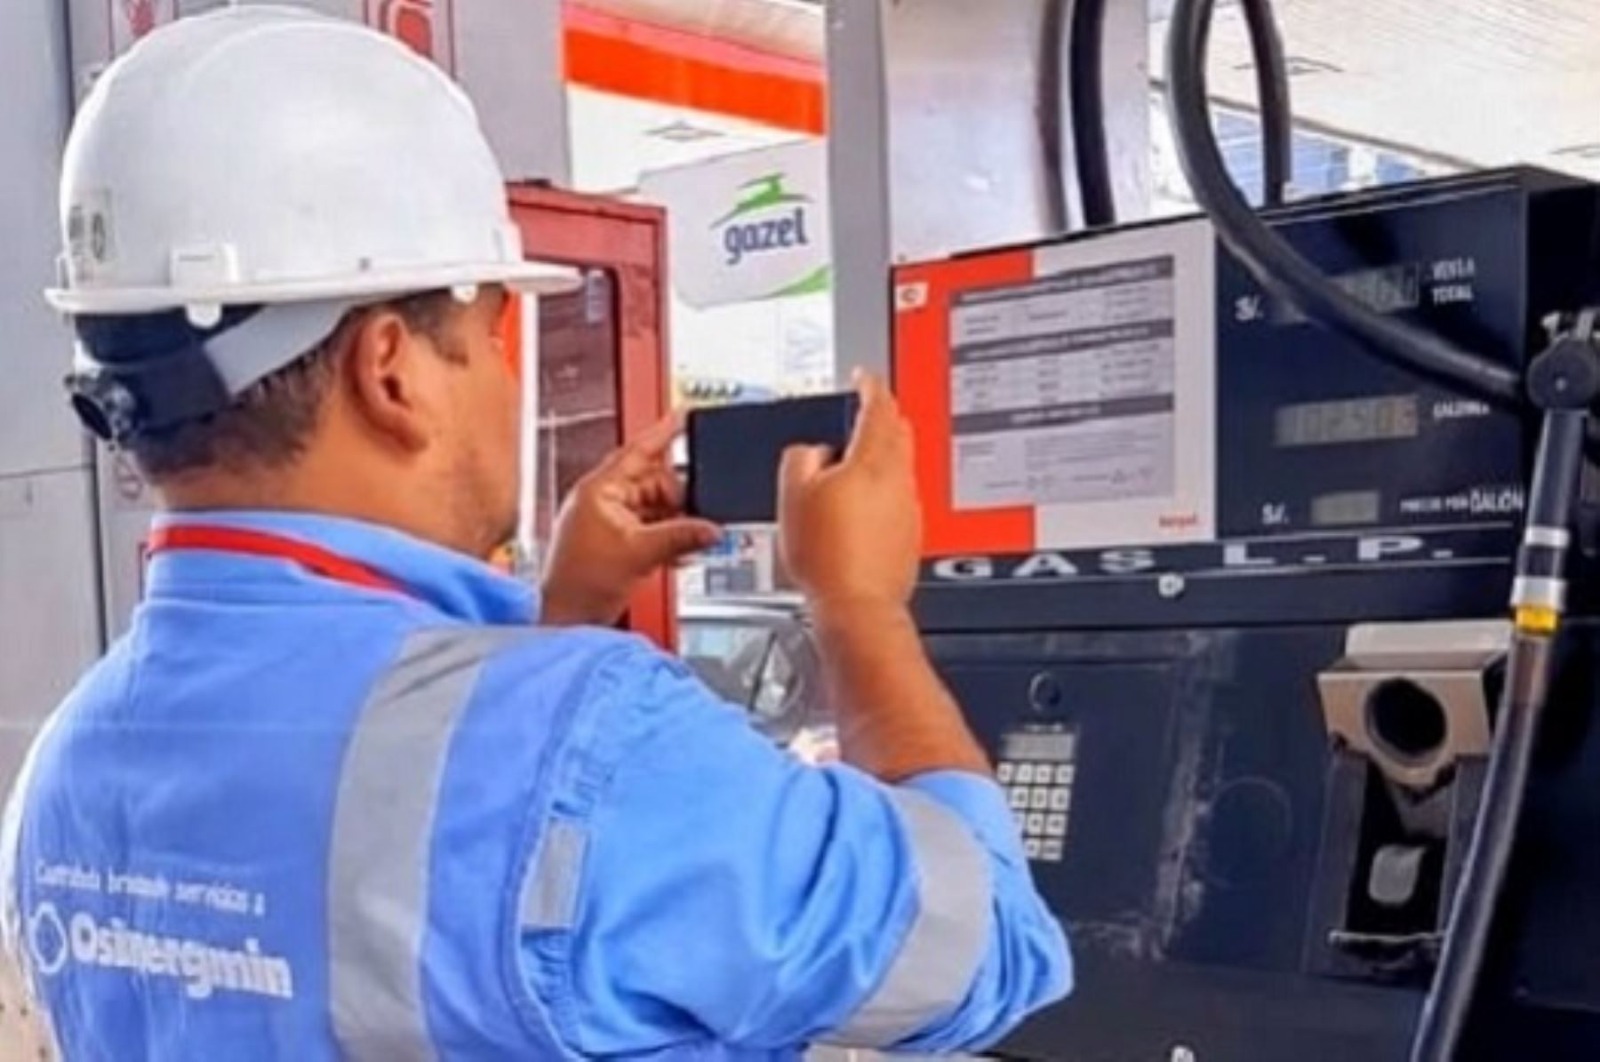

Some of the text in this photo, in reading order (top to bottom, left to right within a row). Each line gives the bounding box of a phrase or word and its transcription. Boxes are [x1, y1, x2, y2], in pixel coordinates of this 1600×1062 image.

[723, 206, 809, 266] gazel
[933, 549, 1155, 579] GAS
[70, 911, 293, 999] Osinergmin
